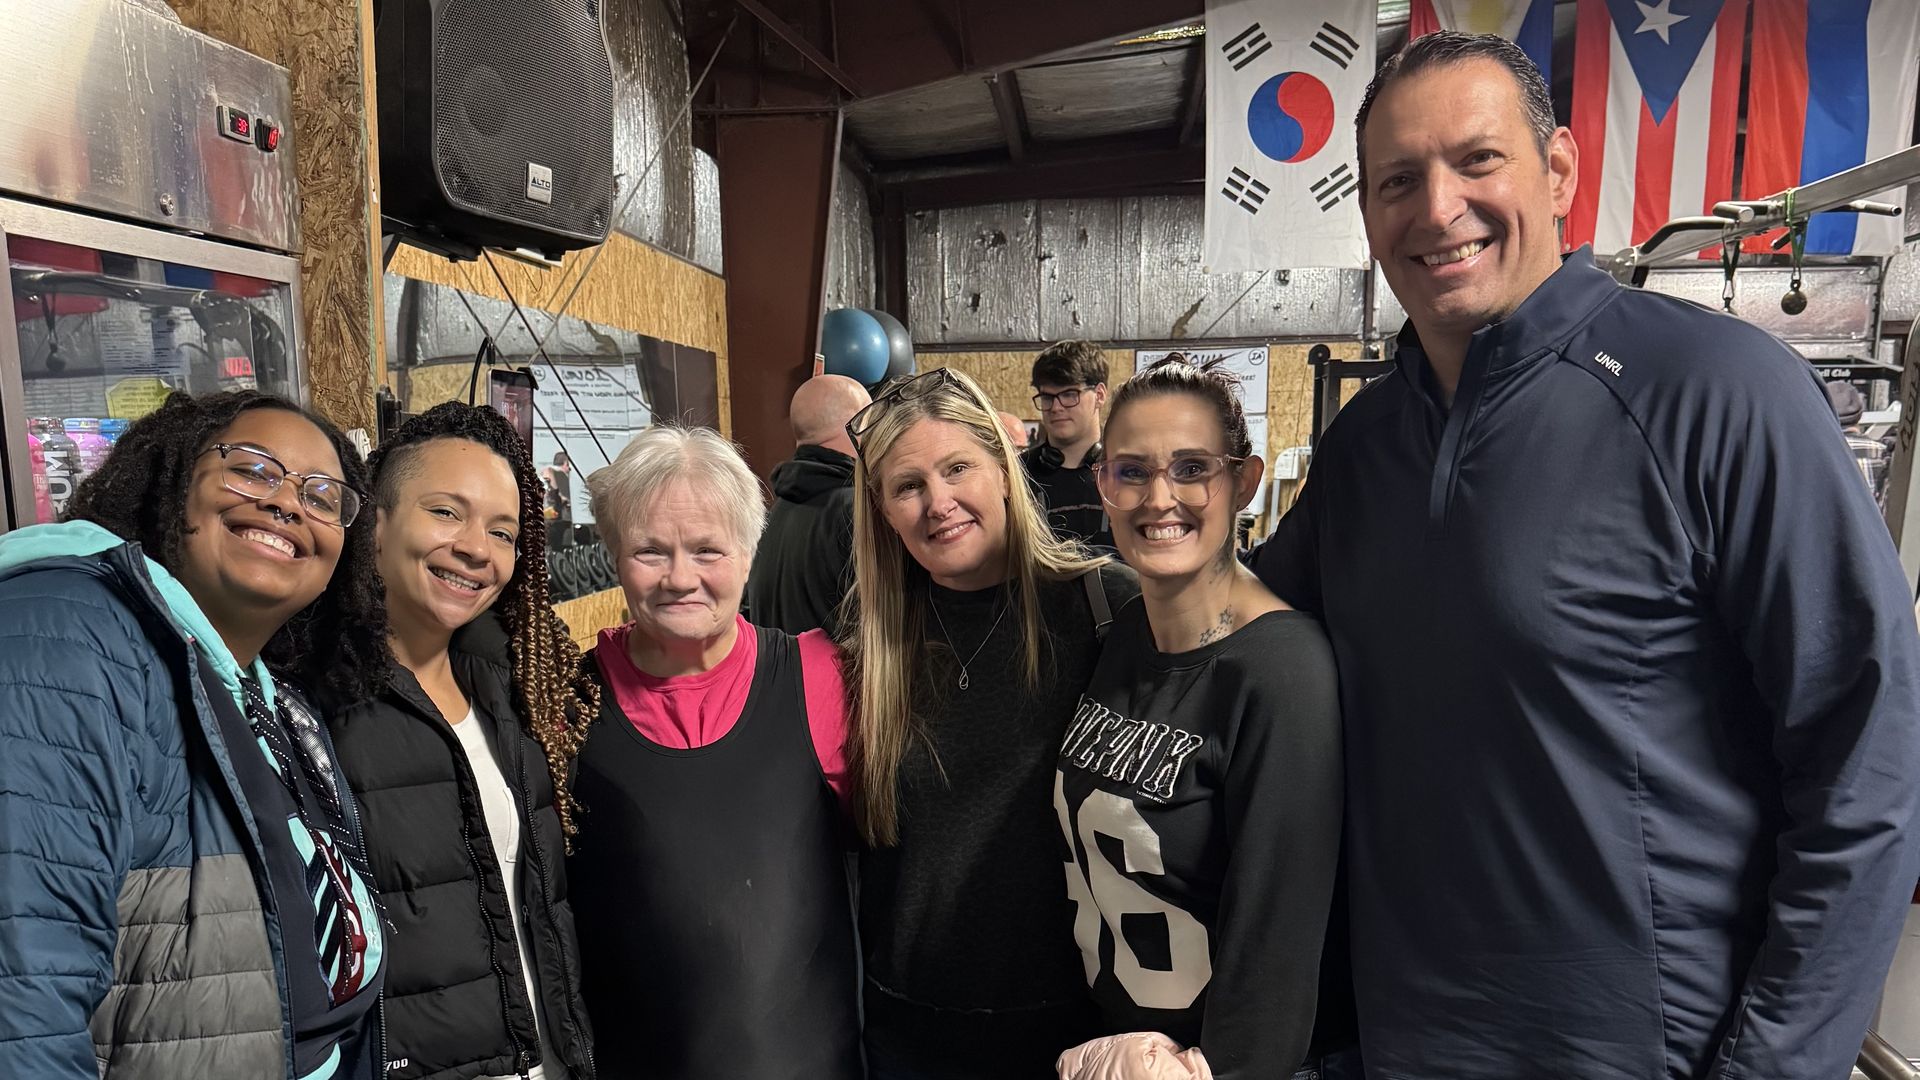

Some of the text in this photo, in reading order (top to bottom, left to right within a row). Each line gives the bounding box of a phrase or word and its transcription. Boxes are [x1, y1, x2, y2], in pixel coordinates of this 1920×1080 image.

[531, 176, 550, 188] ALTO
[1594, 350, 1623, 377] UNRL
[1831, 368, 1851, 378] Club
[384, 1058, 409, 1072] 700
